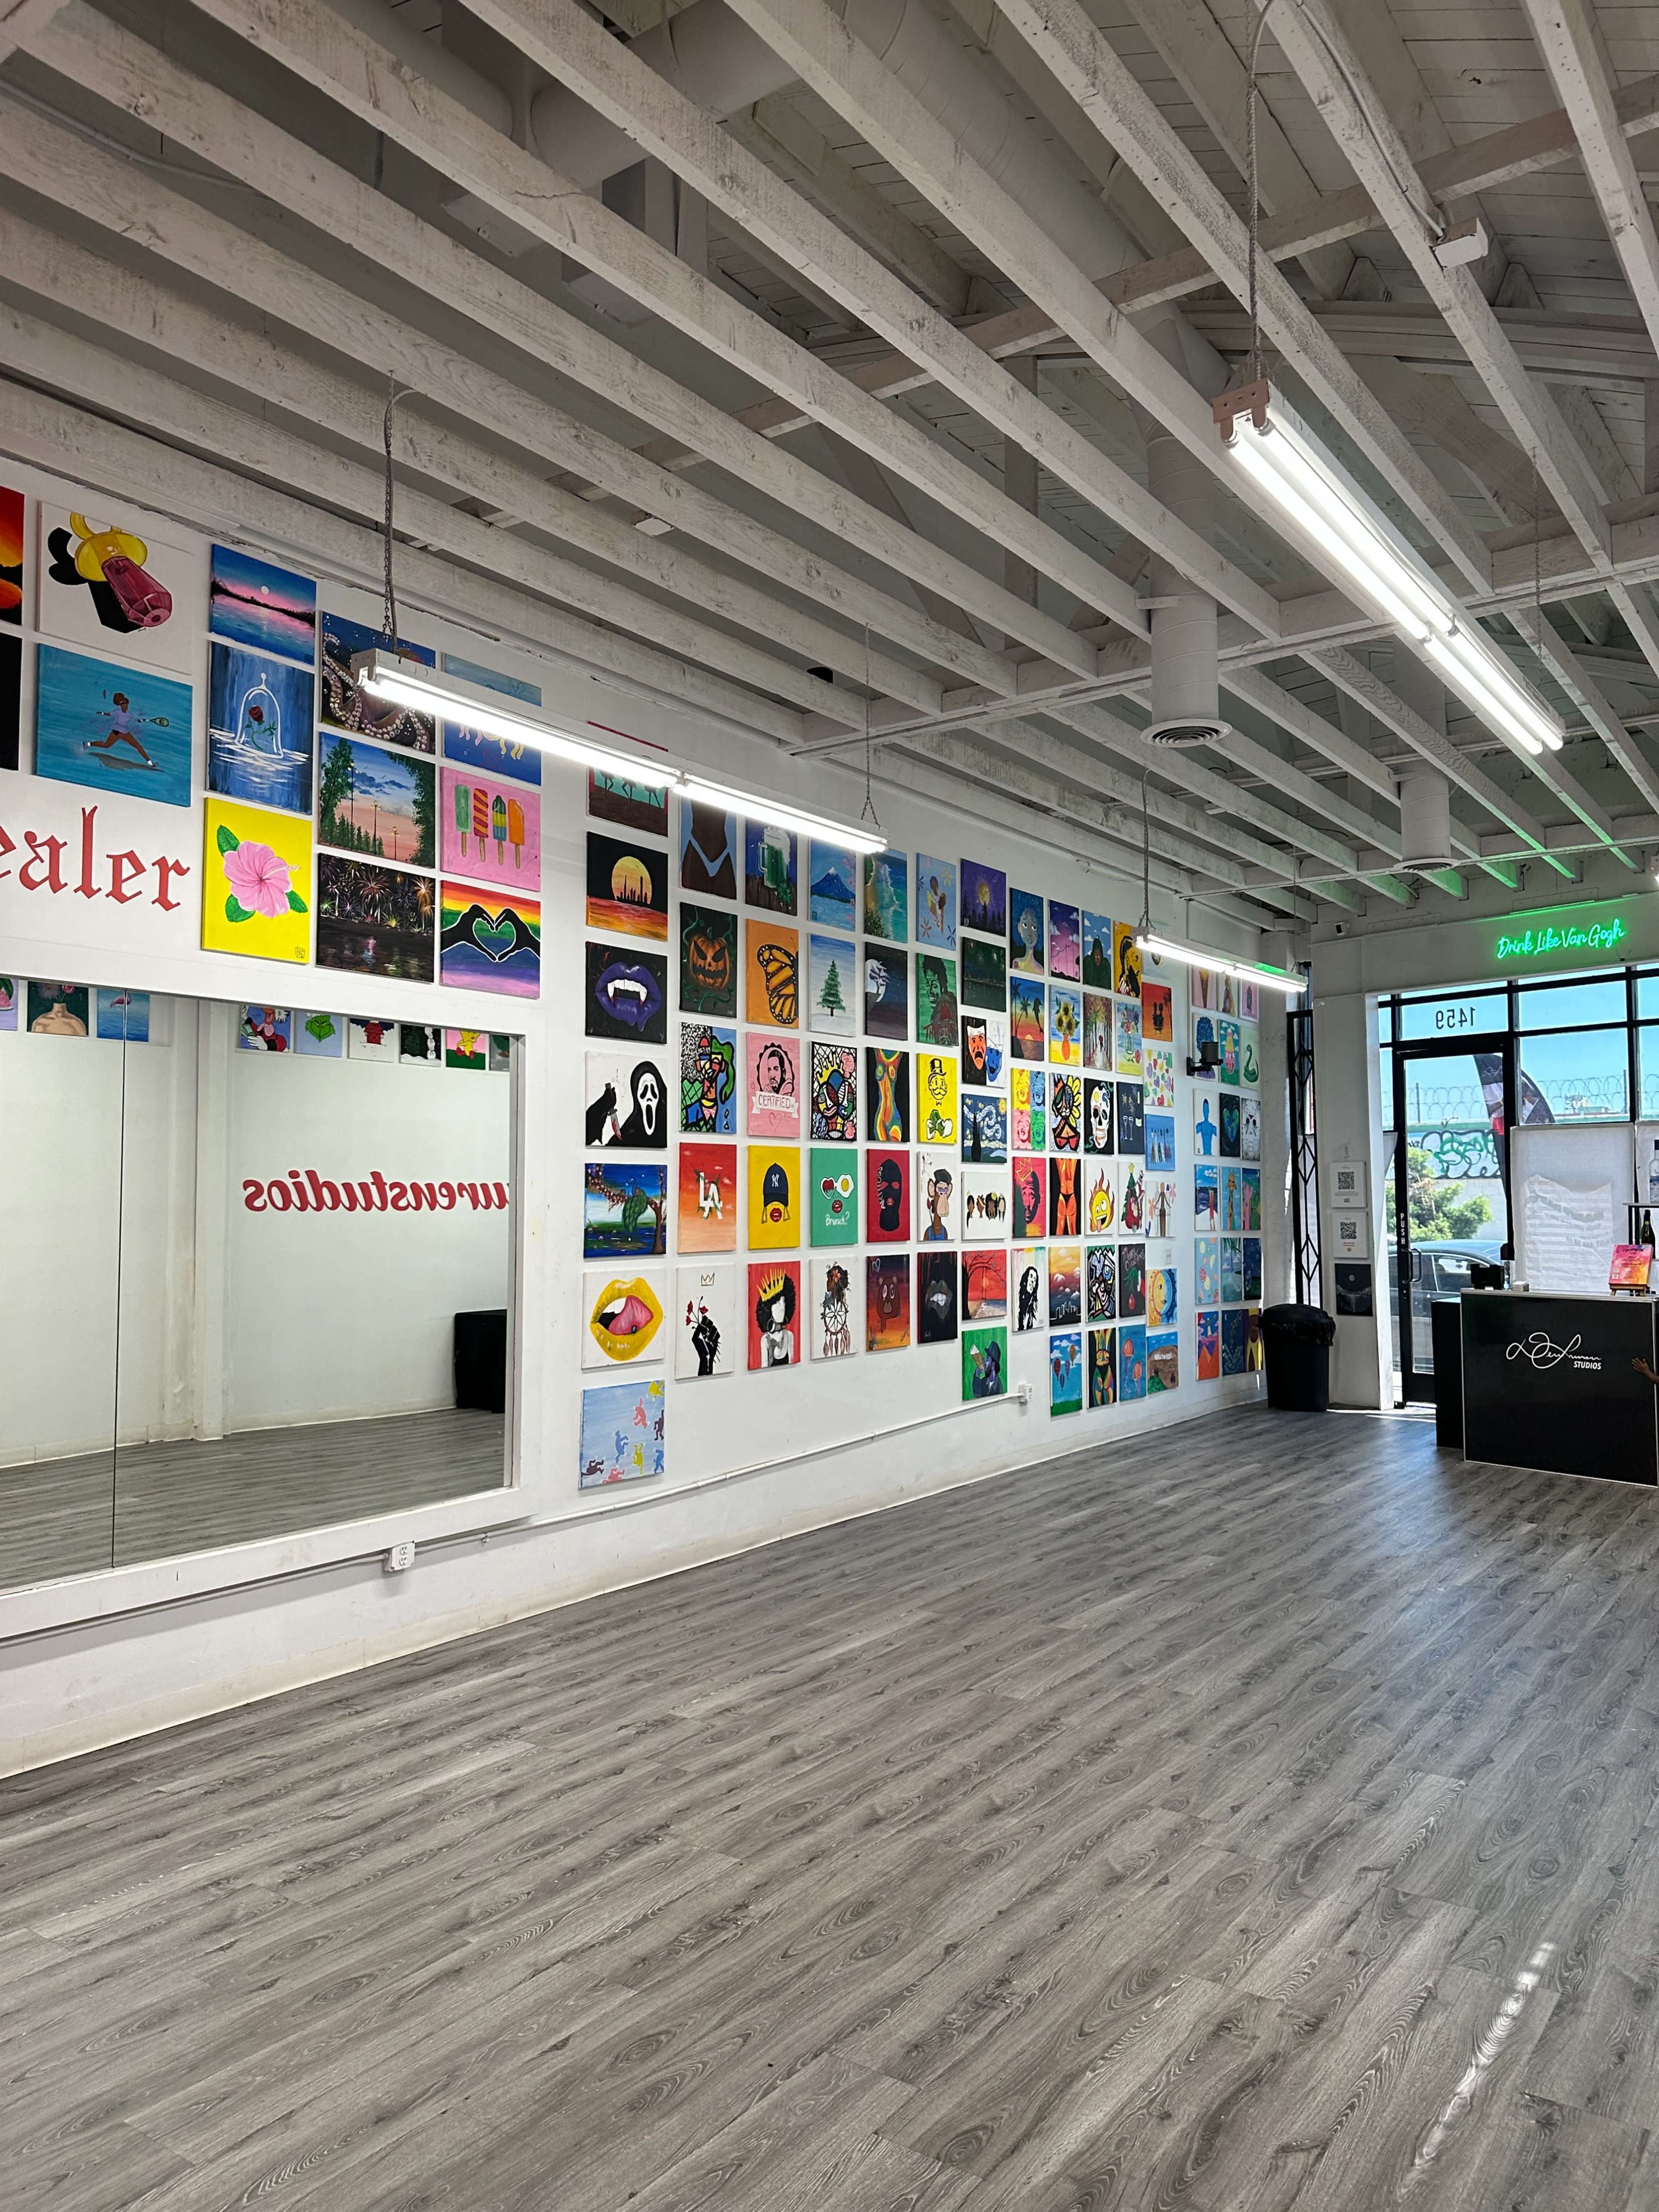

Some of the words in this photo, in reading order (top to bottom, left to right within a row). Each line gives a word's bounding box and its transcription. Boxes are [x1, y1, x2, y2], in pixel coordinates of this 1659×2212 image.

[1497, 930, 1533, 959] Drink
[1534, 928, 1561, 954] Like
[1561, 927, 1588, 947] Van
[1588, 918, 1624, 948] Gogh
[772, 1173, 779, 1187] NY
[699, 1172, 723, 1220] LA
[1573, 1360, 1602, 1370] STUDIOS
